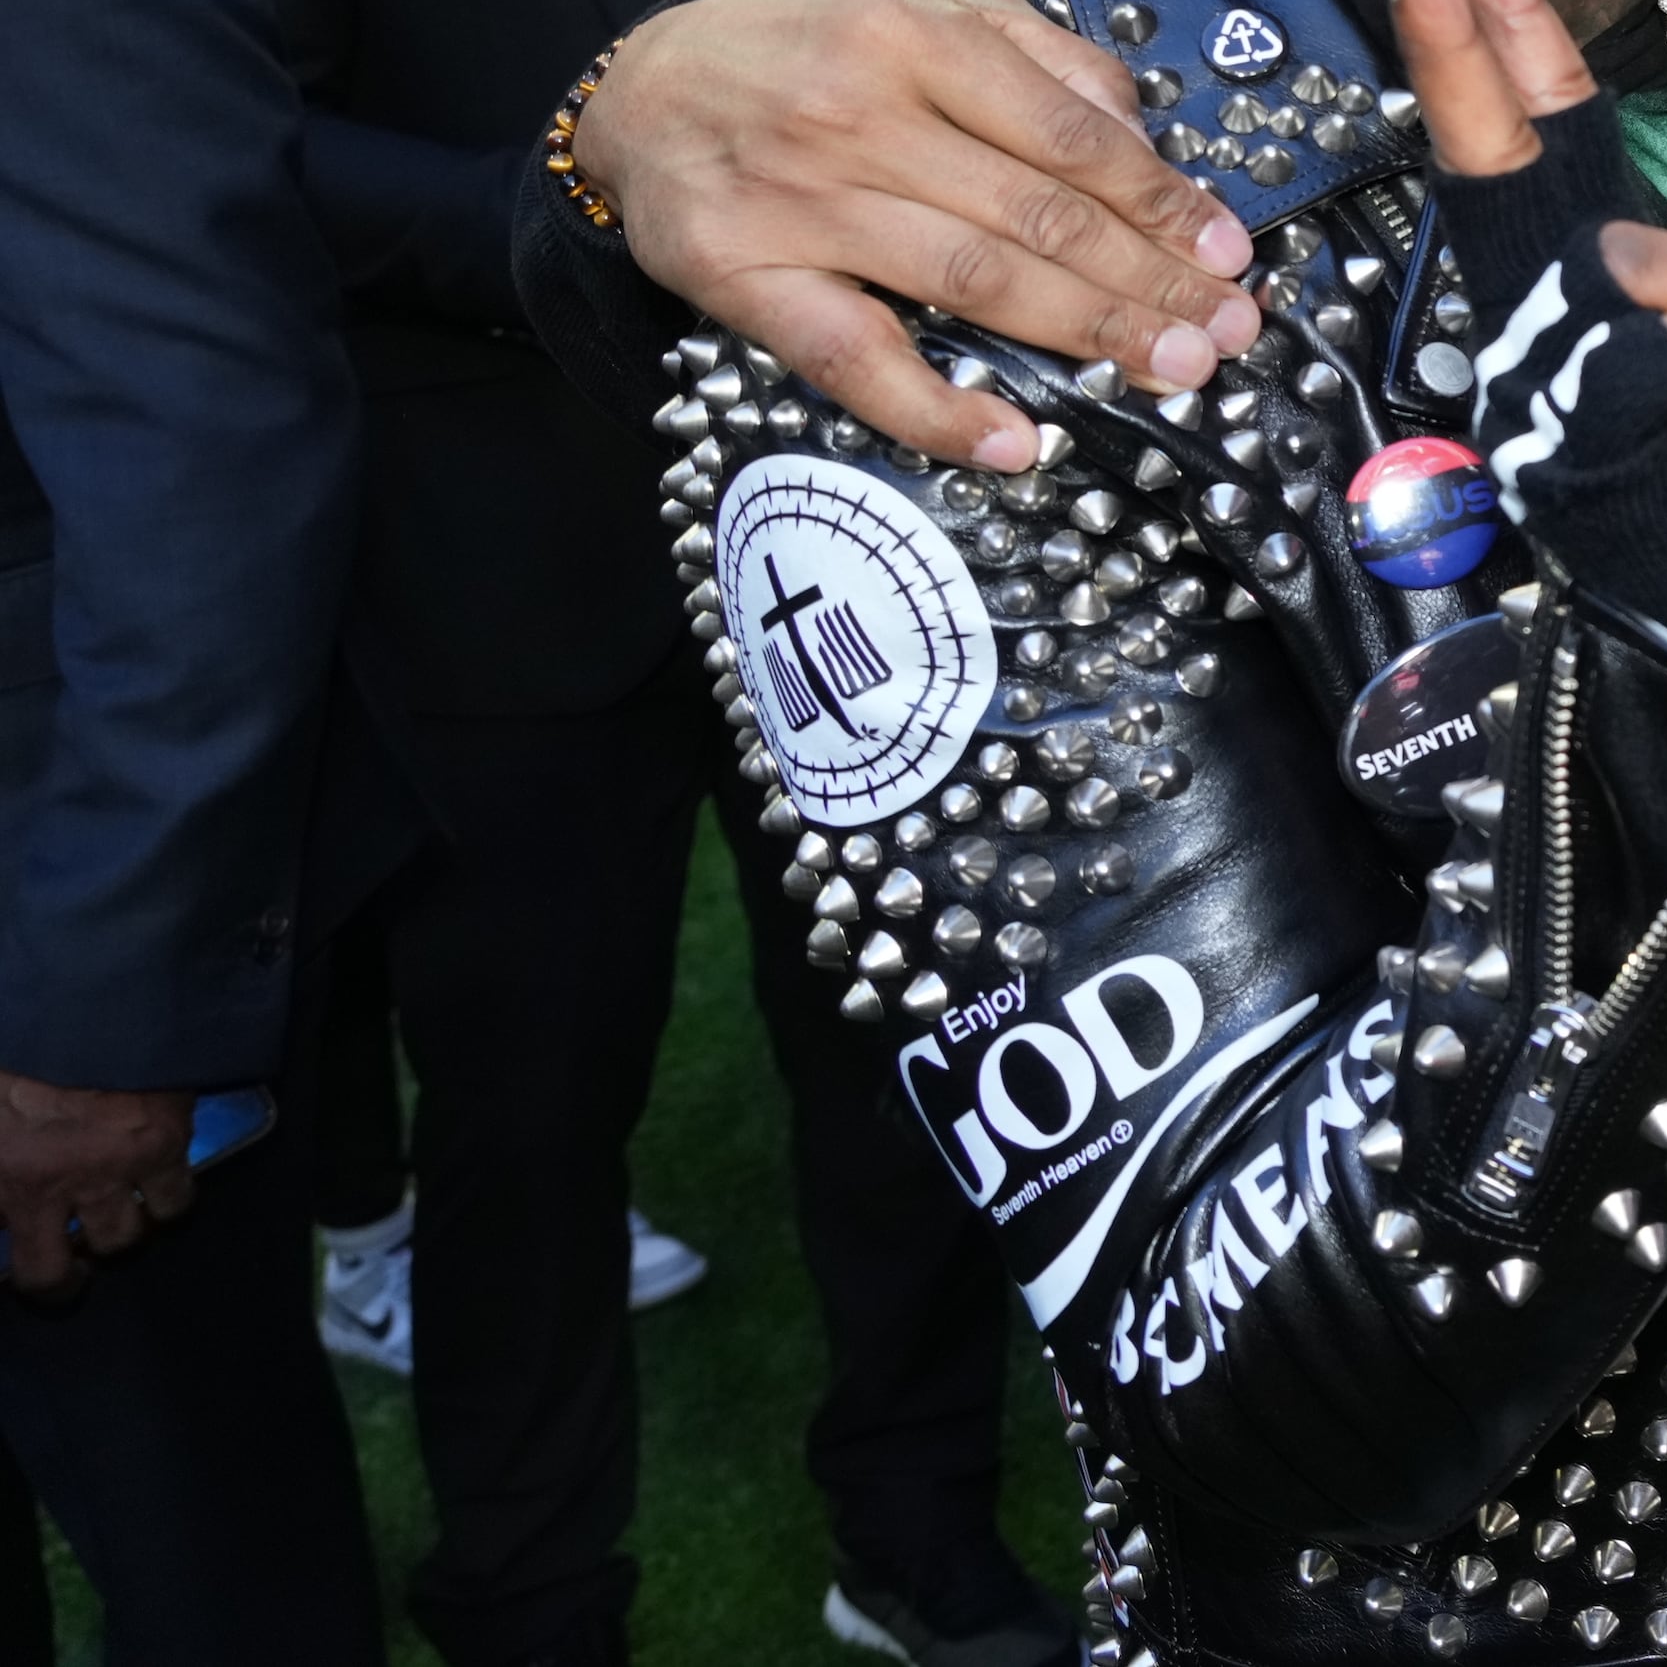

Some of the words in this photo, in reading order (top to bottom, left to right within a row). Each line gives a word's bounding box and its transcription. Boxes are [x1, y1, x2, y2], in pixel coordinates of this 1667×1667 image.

[1355, 713, 1477, 781] SEVENTH
[941, 970, 1026, 1044] Enjoy
[899, 954, 1204, 1209] GOD
[991, 1178, 1043, 1226] Seventh
[1040, 1134, 1113, 1189] Heaven
